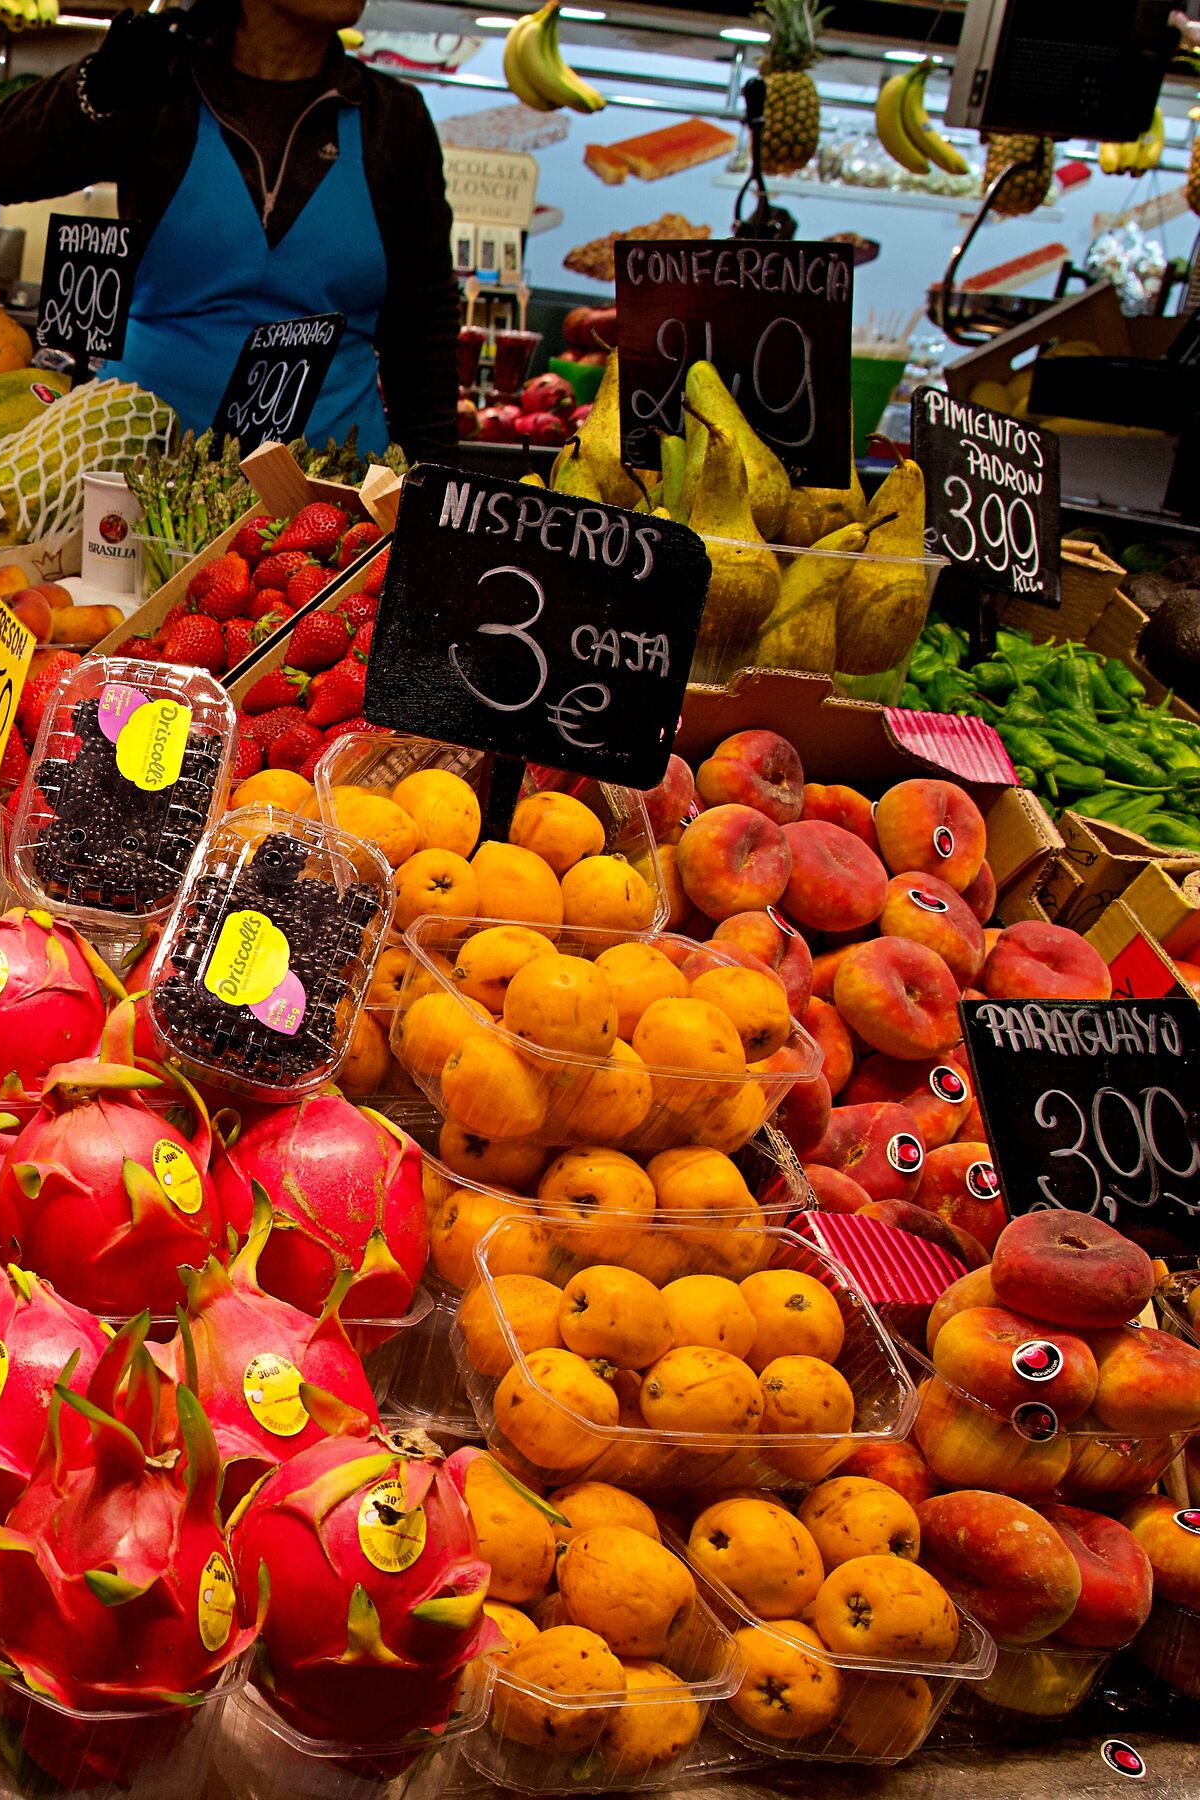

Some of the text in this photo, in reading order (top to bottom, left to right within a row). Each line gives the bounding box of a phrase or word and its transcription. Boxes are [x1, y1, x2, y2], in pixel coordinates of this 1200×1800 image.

[58, 223, 130, 257] PAPAYAS
[626, 247, 850, 302] CONFERENCIA
[250, 321, 334, 351] ESPARRAGO
[924, 390, 1043, 468] PIMIENTOS
[960, 439, 1043, 495] PADRON
[88, 541, 136, 559] BRASILIA
[438, 481, 662, 580] NISPEROS
[448, 565, 549, 711] 3
[571, 624, 670, 677] CAJA
[545, 683, 611, 748] €
[145, 706, 179, 785] Driscoll's
[219, 916, 261, 997] Driscoll's
[285, 1007, 301, 1029] 125 g
[976, 1003, 1183, 1056] PARAGUAYO
[258, 1366, 280, 1380] 3040
[371, 1481, 396, 1495] PRODUCT
[384, 1494, 402, 1506] 30
[364, 1538, 392, 1567] DRAGON
